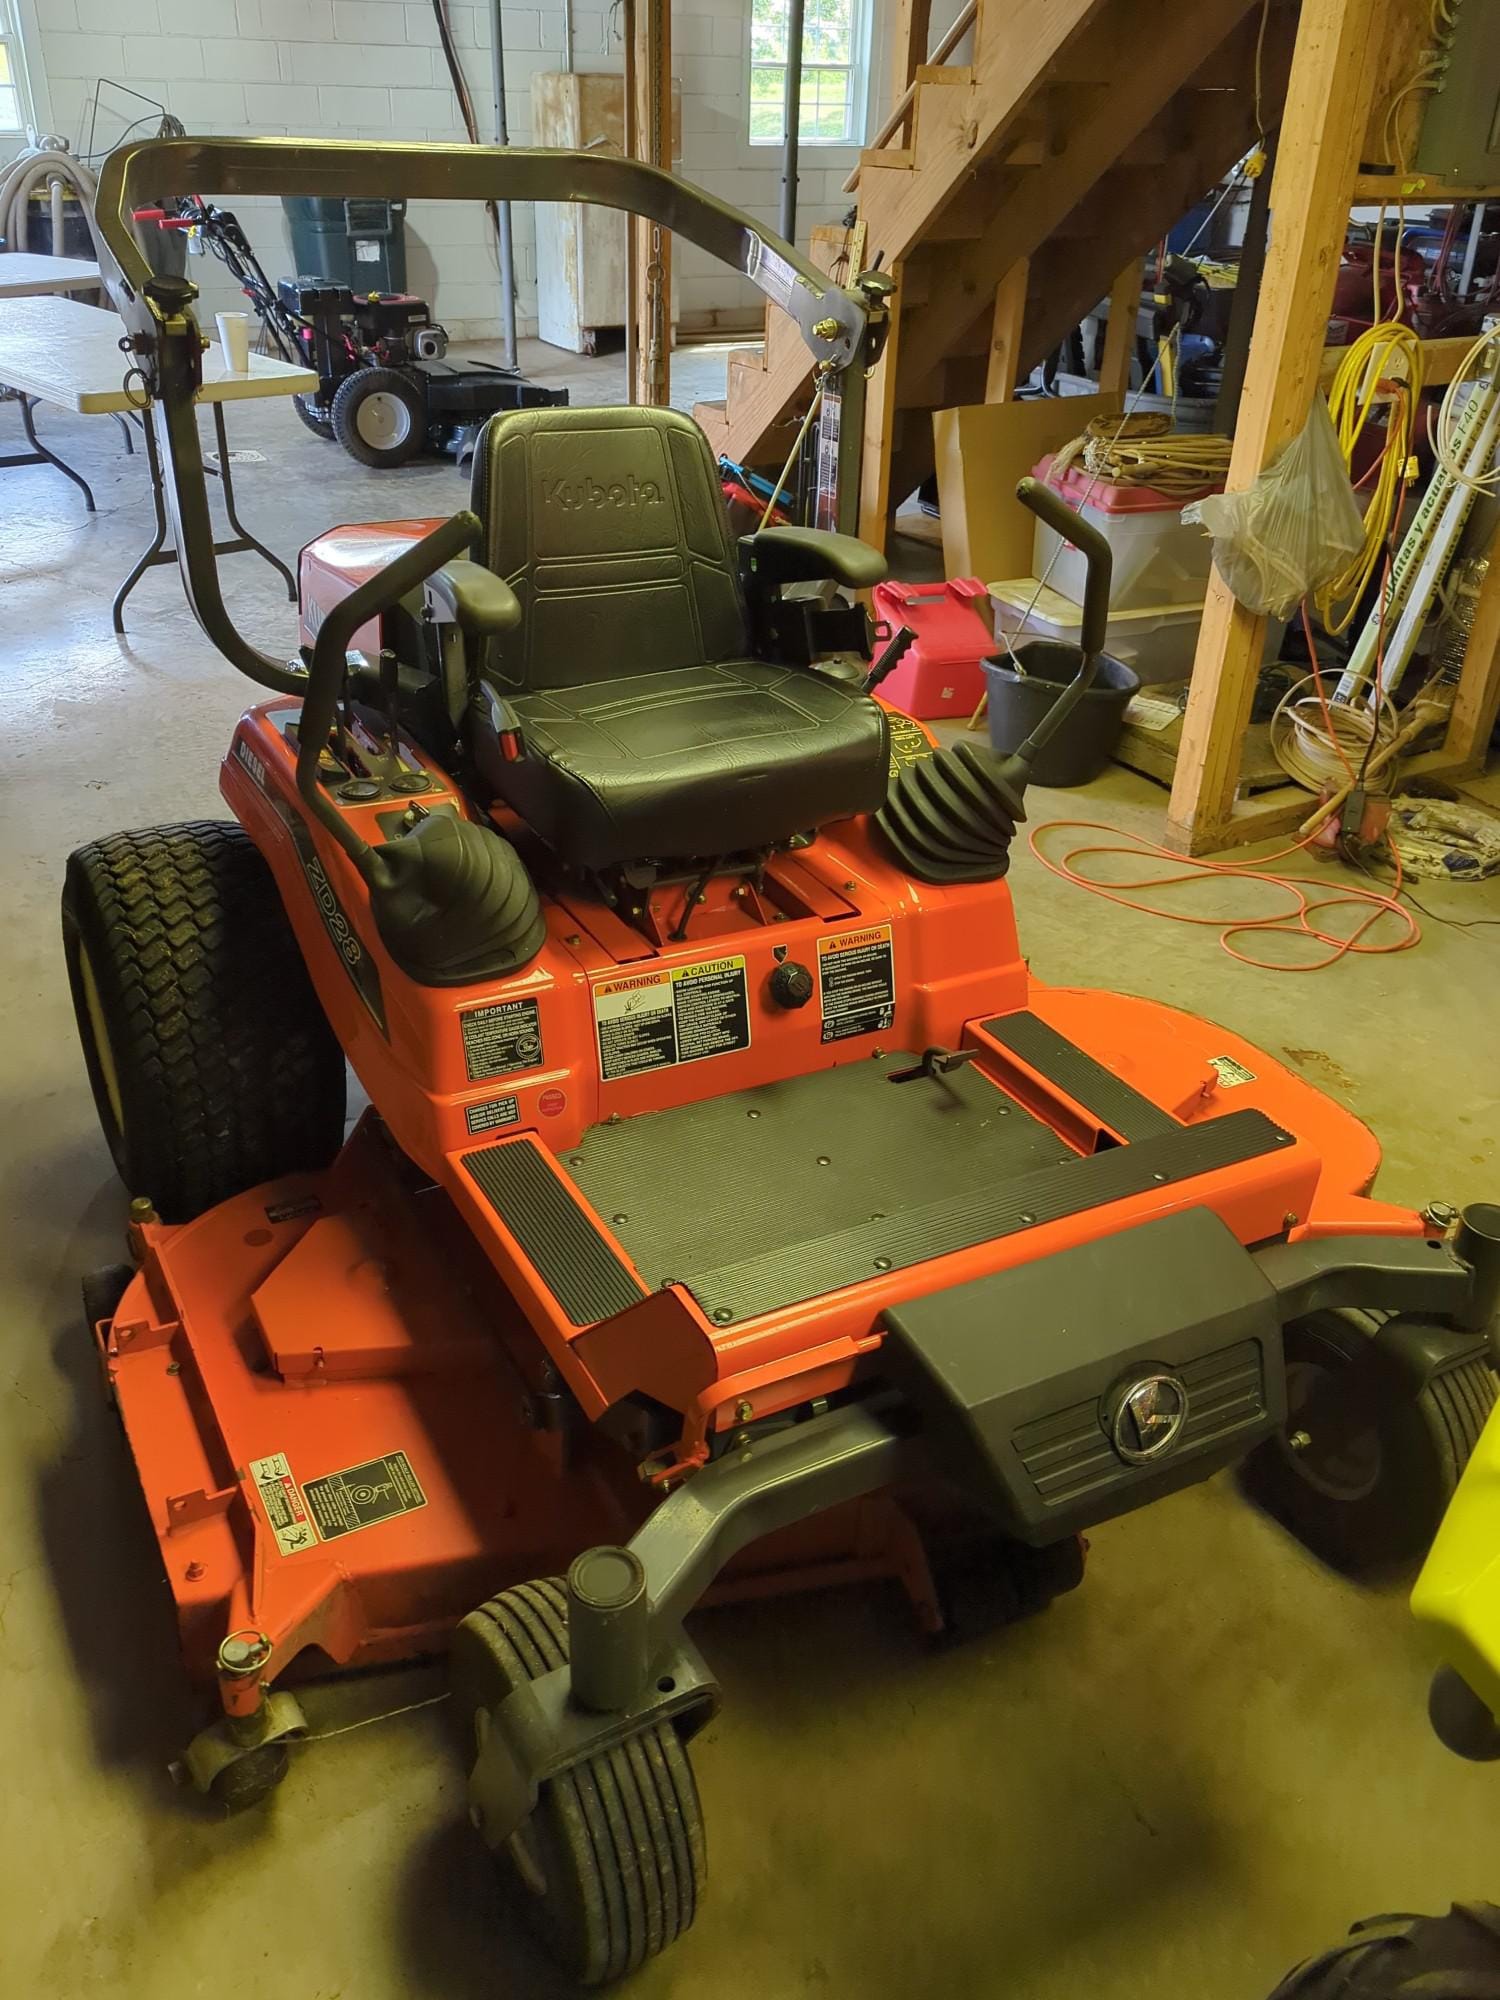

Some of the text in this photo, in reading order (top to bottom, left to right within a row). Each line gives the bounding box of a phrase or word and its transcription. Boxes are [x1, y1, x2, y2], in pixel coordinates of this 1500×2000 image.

[541, 474, 663, 510] Kubota
[1414, 521, 1424, 536] y
[240, 741, 265, 786] DIESEL
[306, 856, 361, 965] ZD28
[840, 932, 881, 947] WARNING
[691, 960, 734, 976] CAUTION
[613, 975, 661, 992] WARNING
[474, 1002, 523, 1018] IMPORTANT
[287, 1488, 303, 1516] DANGER
